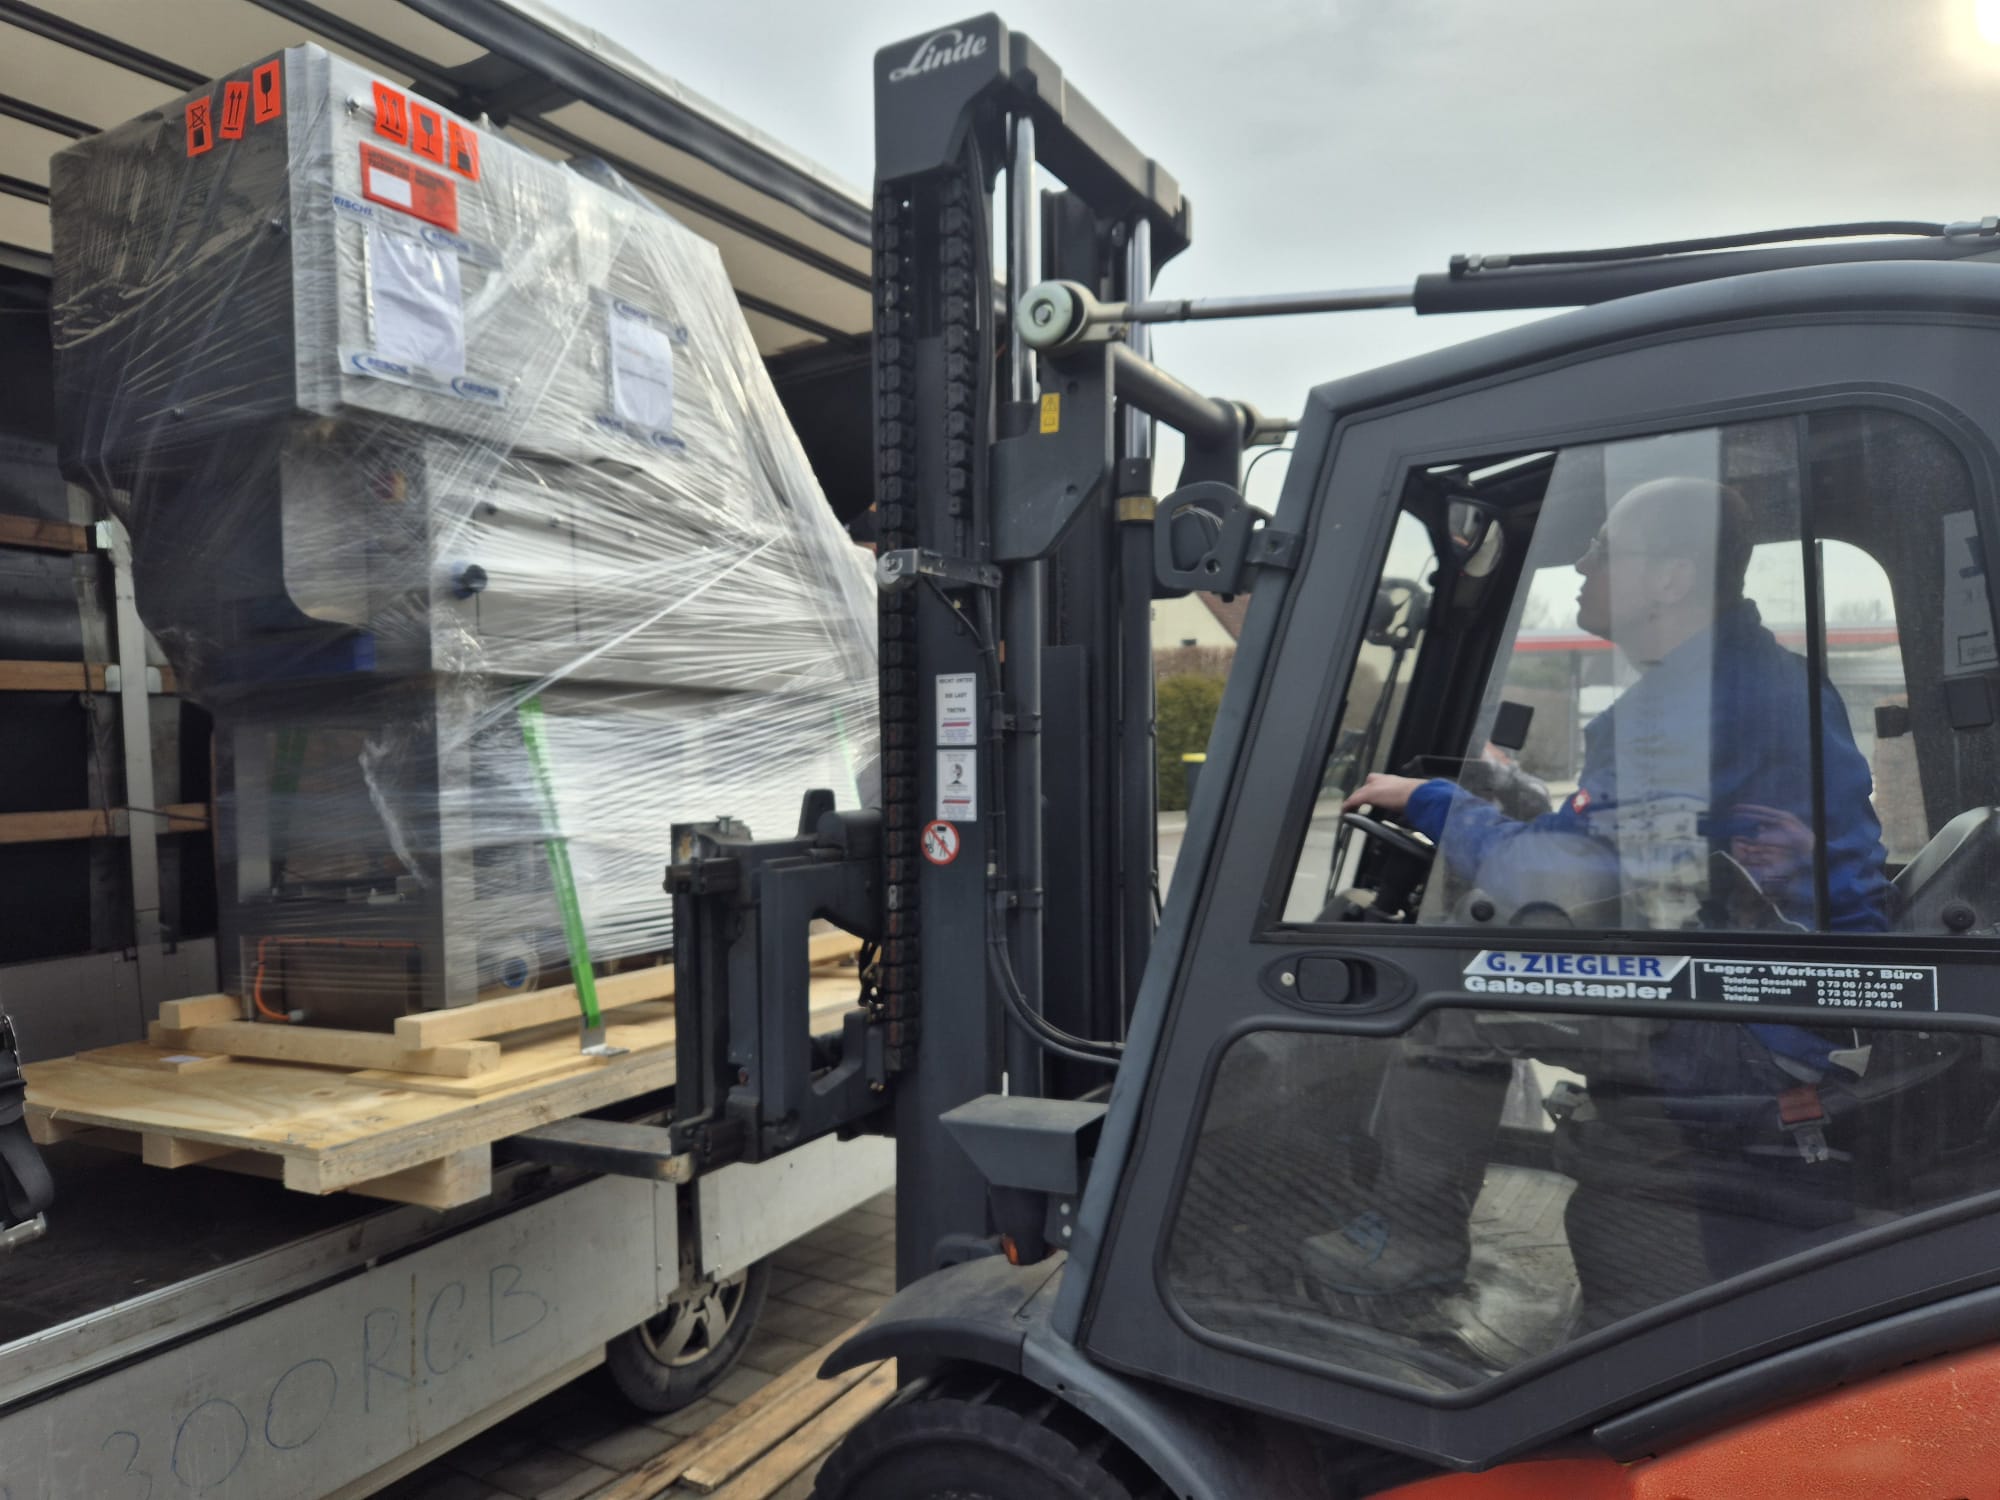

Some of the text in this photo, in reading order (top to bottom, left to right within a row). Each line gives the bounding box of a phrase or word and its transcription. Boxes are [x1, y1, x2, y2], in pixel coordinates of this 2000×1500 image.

[889, 29, 987, 82] Linde
[1703, 963, 1923, 980] Lager Werkstatt Büro
[1464, 975, 1672, 1000] Gabelstapler
[1722, 976, 1759, 985] Telefon
[1722, 985, 1760, 993] Telefon
[1760, 986, 1791, 995] Privat
